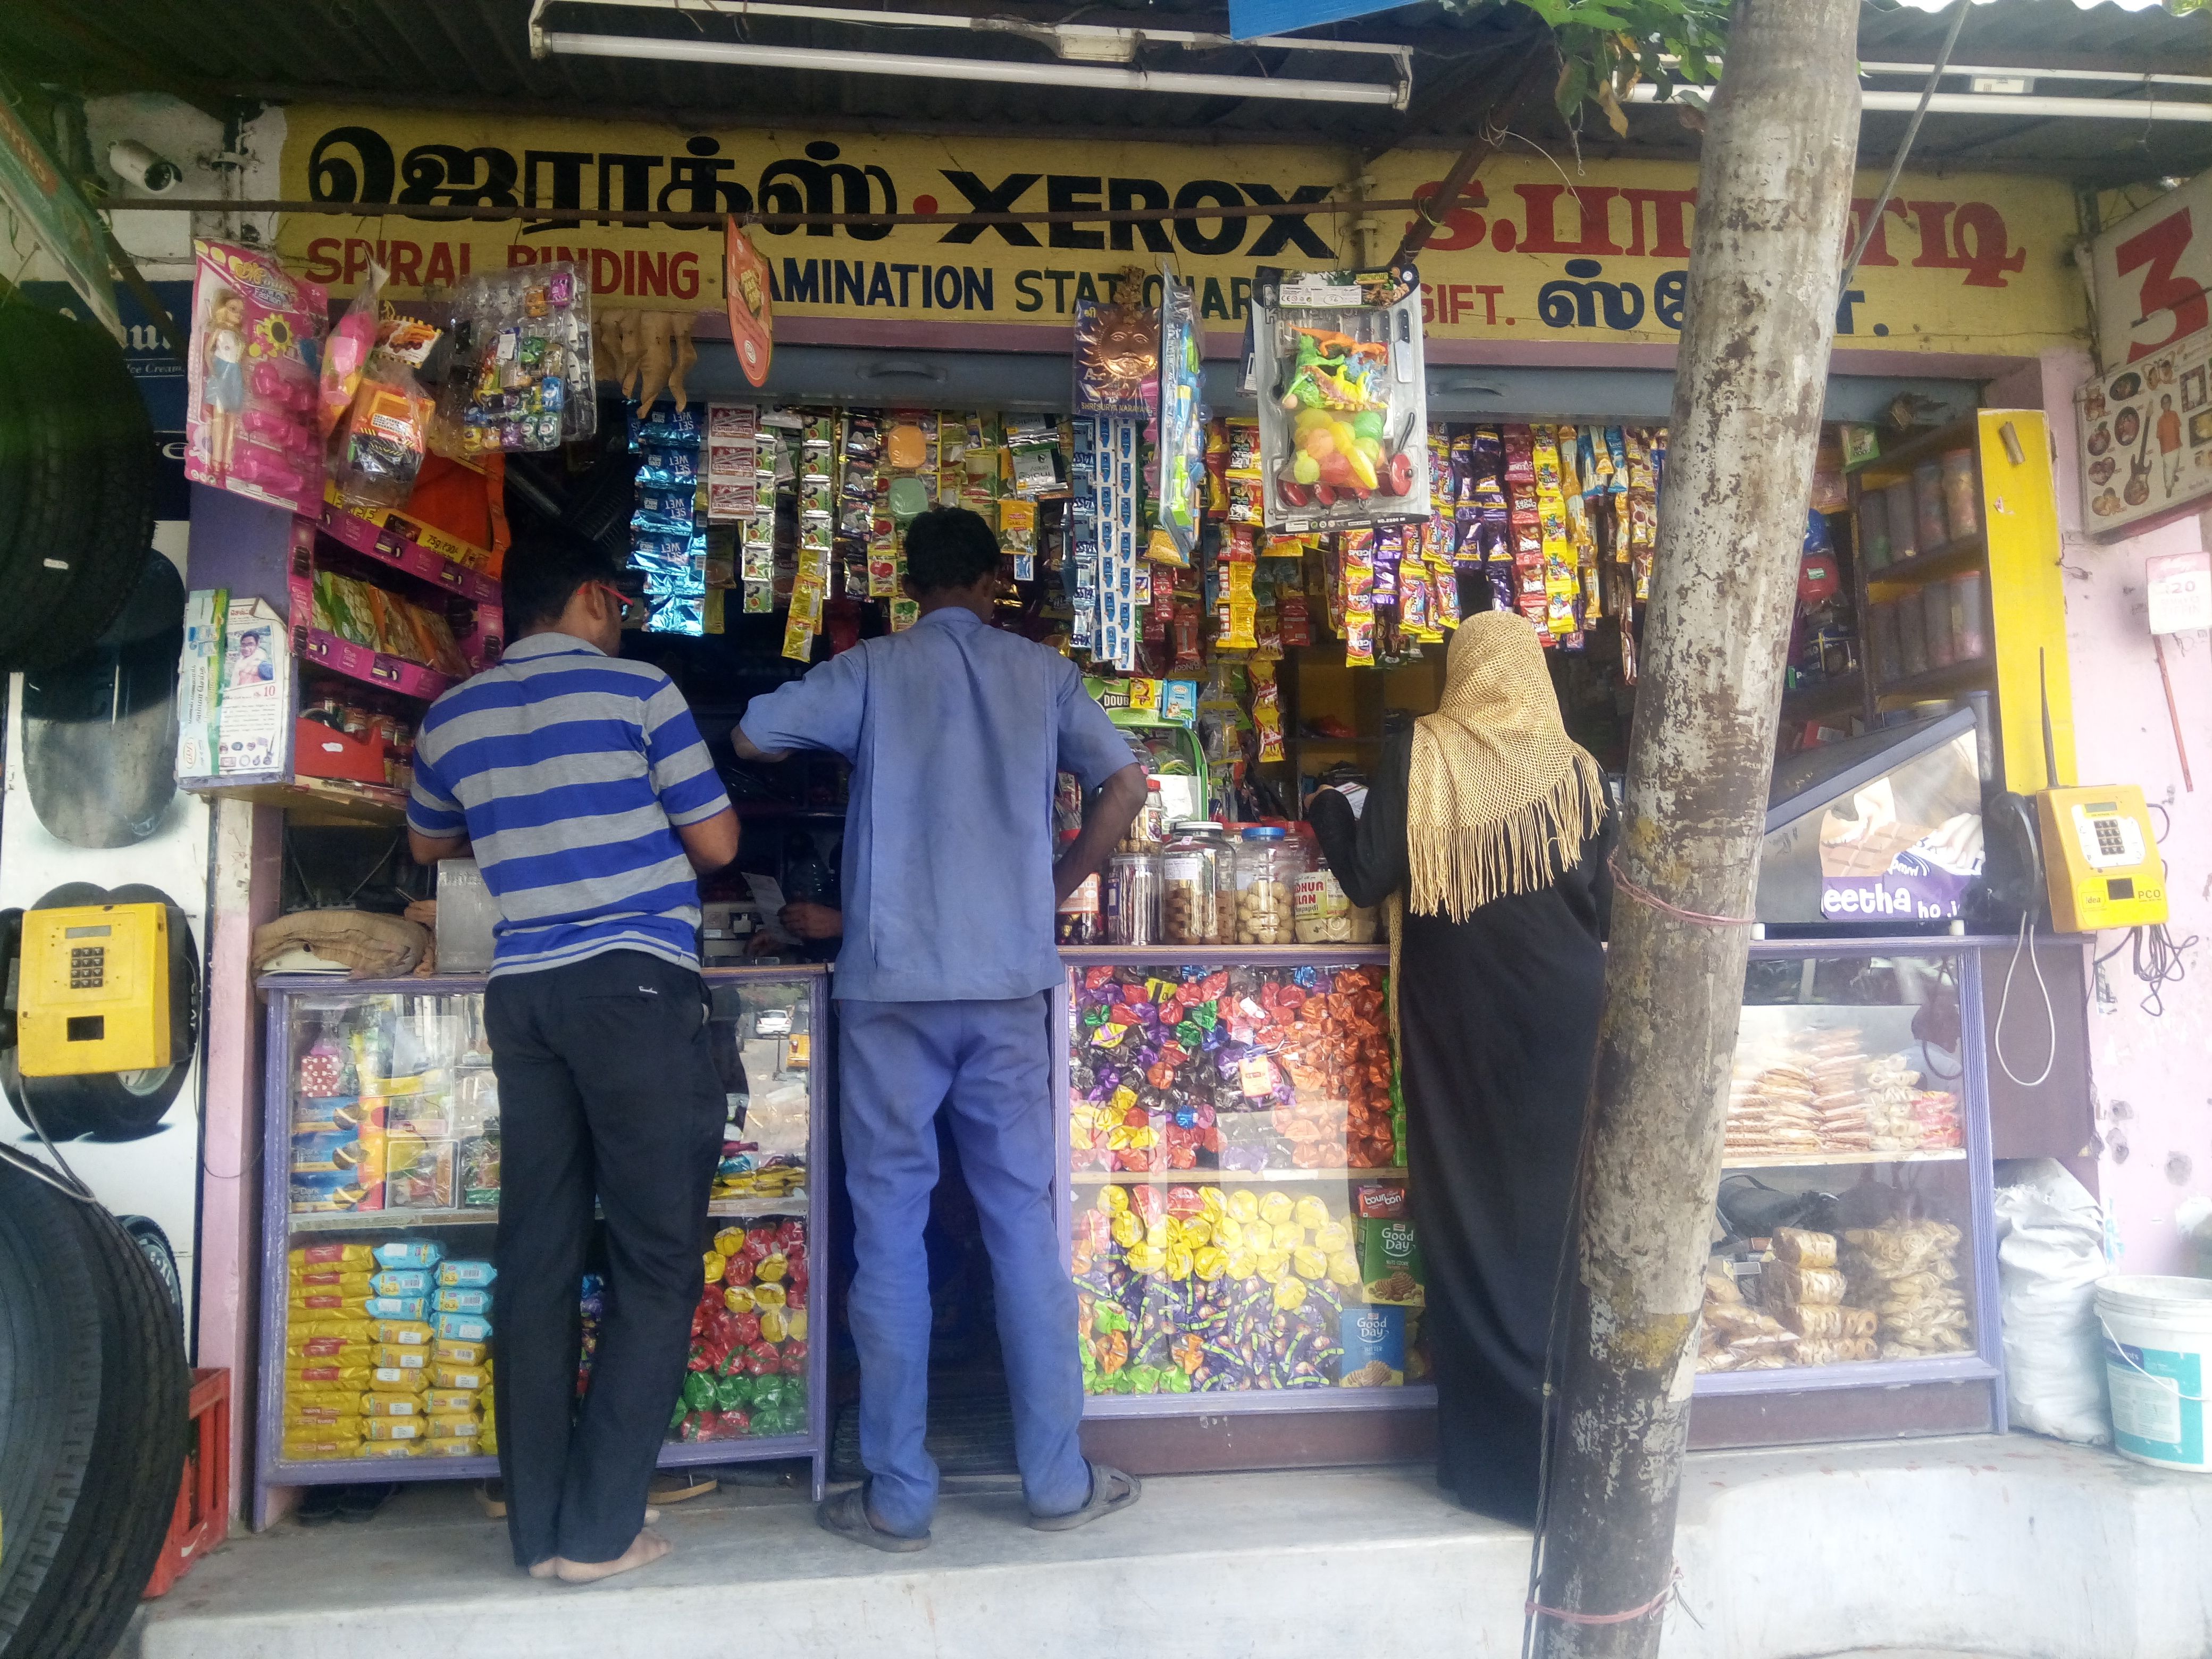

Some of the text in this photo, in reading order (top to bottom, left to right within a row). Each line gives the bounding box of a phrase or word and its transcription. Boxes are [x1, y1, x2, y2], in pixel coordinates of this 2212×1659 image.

[937, 169, 1339, 259] XEROX
[668, 455, 689, 465] WET
[674, 464, 690, 475] SET
[665, 498, 685, 509] WET
[1515, 501, 1536, 510] CHOCO
[670, 507, 686, 519] SET
[263, 685, 276, 697] 10
[2138, 889, 2161, 899] PCO
[1821, 883, 1912, 914] eetha
[1917, 901, 1941, 918] ho
[1364, 1194, 1402, 1205] bourbon
[1381, 1228, 1414, 1242] Good
[1386, 1239, 1410, 1252] Day
[1356, 1316, 1387, 1328] Good
[1361, 1327, 1384, 1339] Day
